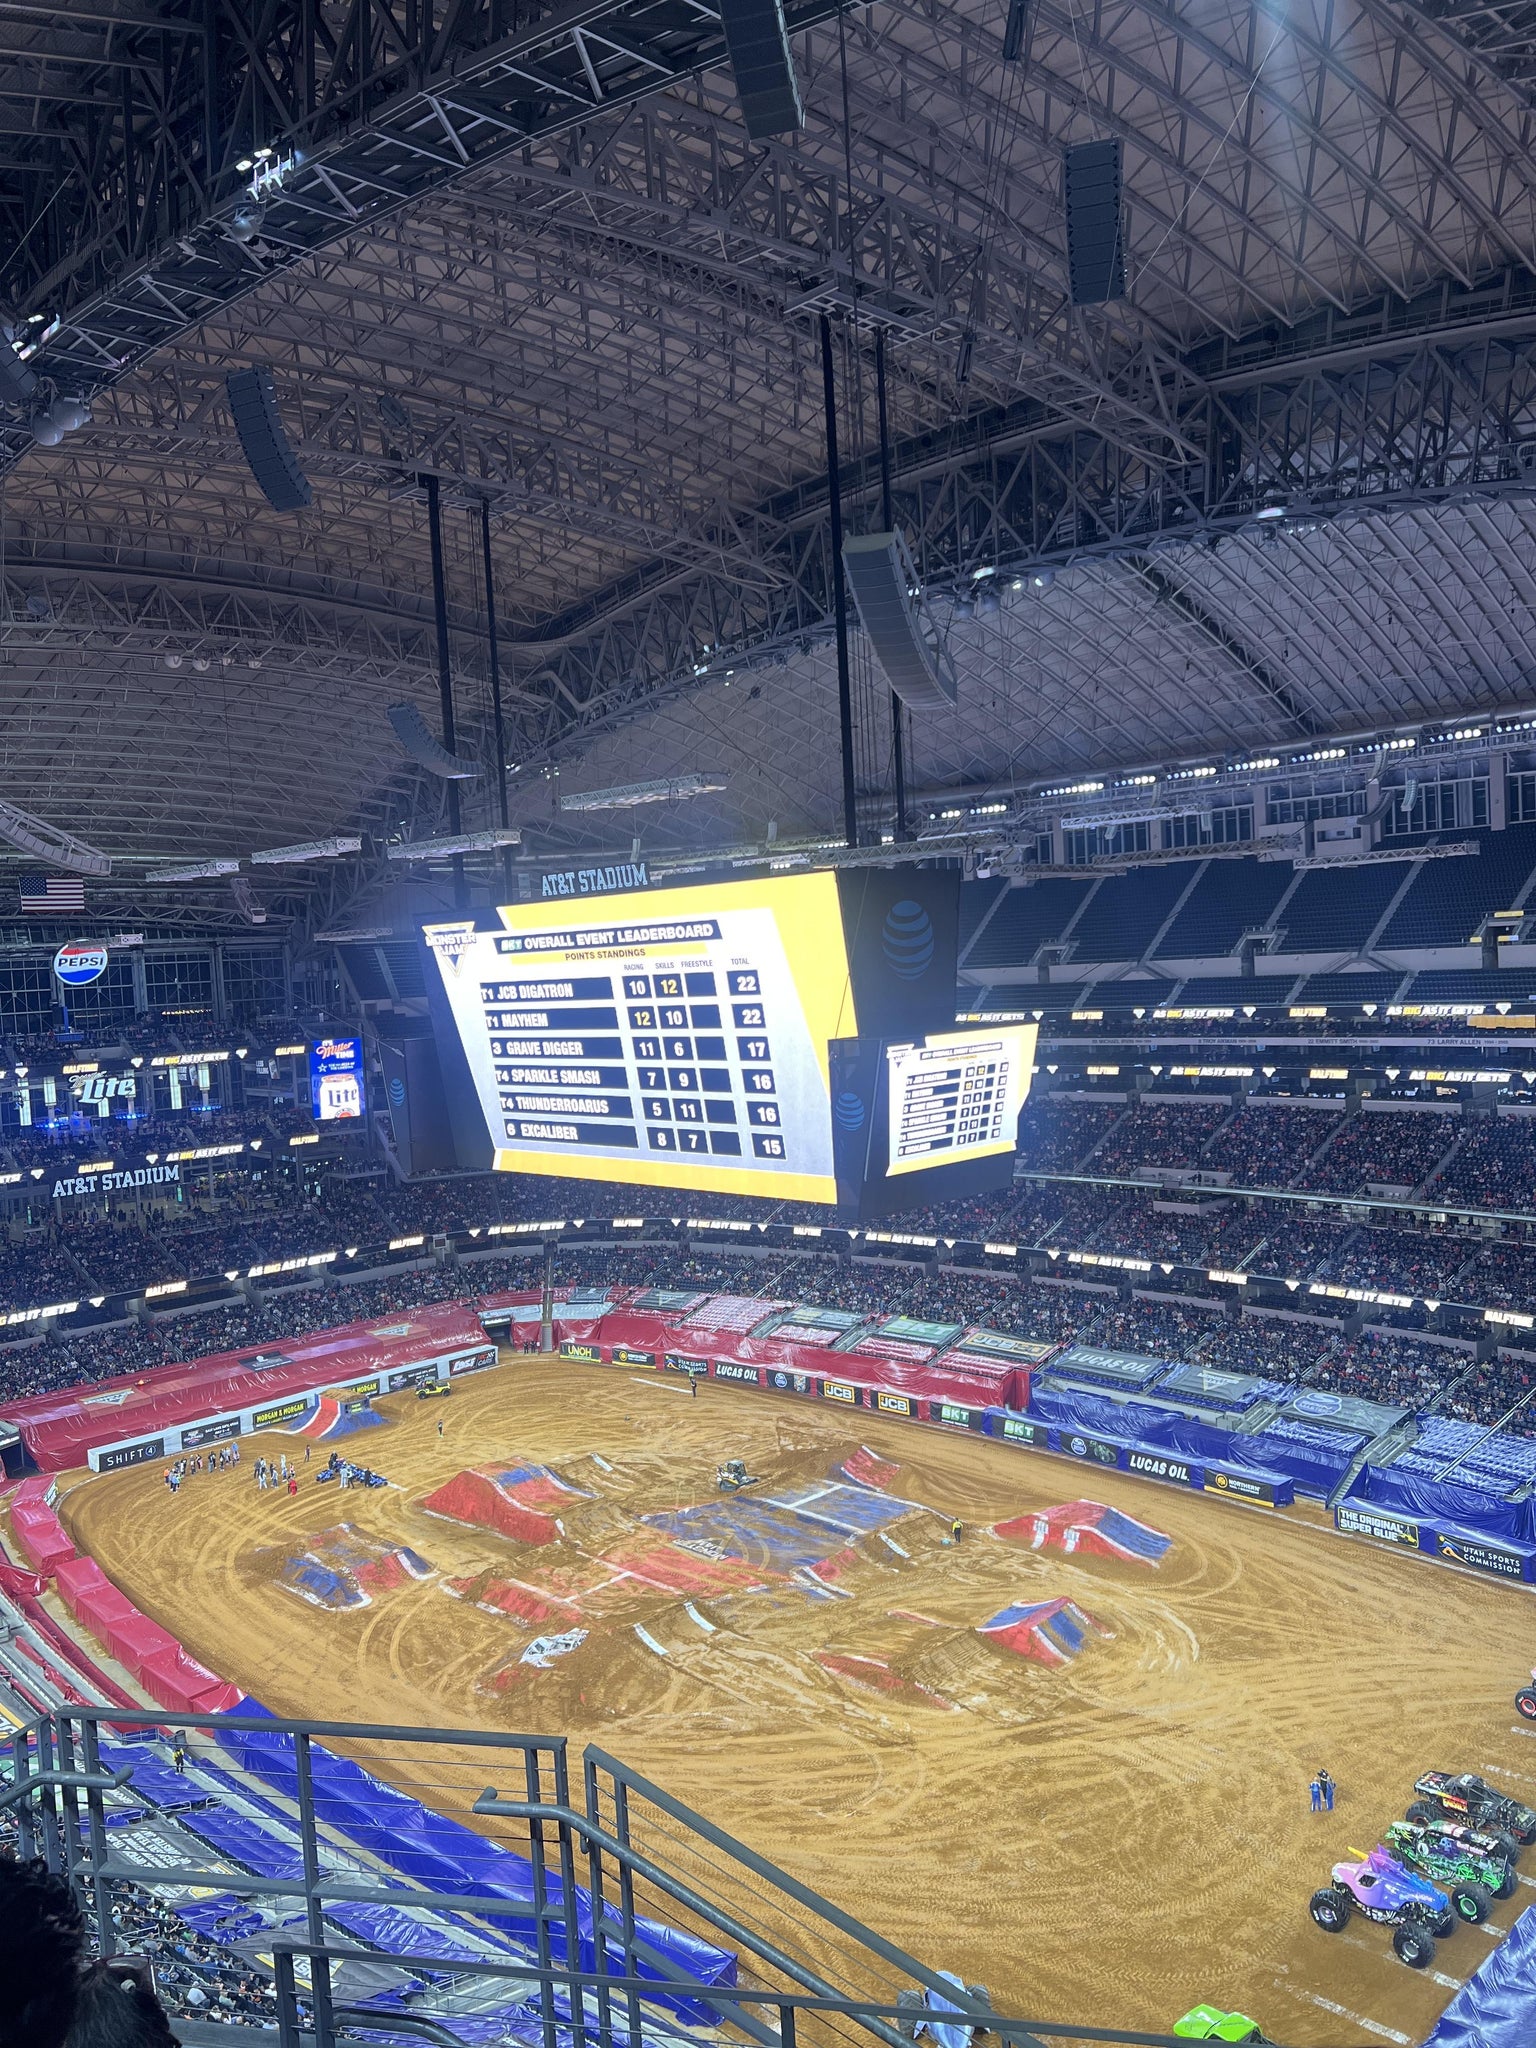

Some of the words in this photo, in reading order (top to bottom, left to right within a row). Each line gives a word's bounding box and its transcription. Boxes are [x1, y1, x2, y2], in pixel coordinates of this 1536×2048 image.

[542, 872, 575, 897] AT&T
[579, 864, 648, 893] STADIUM
[524, 936, 574, 950] OVERALL
[576, 932, 614, 946] EVENT
[617, 924, 714, 943] LEADERBOARD
[58, 956, 103, 968] PEPSI
[565, 950, 594, 961] POINTS
[597, 948, 646, 959] STANDINGS
[655, 962, 674, 970] SKILLS
[680, 960, 713, 968] FREESTYLE
[481, 988, 494, 1000] T1
[498, 986, 518, 1000] JCB
[519, 983, 574, 998] DIGATRON
[629, 980, 646, 995] 10
[660, 980, 678, 994] 12
[737, 976, 757, 992] 22
[486, 1016, 498, 1028] T1
[501, 1014, 548, 1028] MAYHEM
[634, 1012, 650, 1026] 12
[666, 1010, 682, 1026] 10
[742, 1009, 762, 1024] 22
[1153, 1010, 1167, 1018] AS
[1167, 1010, 1182, 1018] BIG
[1182, 1009, 1196, 1018] AS
[1196, 1009, 1206, 1018] IT
[1386, 1006, 1402, 1016] AS
[1402, 1006, 1421, 1016] BIG
[1421, 1006, 1437, 1016] AS
[1437, 1006, 1450, 1016] IT
[316, 1042, 354, 1059] Miller
[336, 1050, 354, 1058] TIME
[492, 1042, 502, 1055] 3
[506, 1042, 541, 1055] GRAVE
[543, 1042, 584, 1055] DIGGER
[640, 1042, 654, 1056] 11
[674, 1042, 684, 1056] 6
[747, 1042, 765, 1058] 17
[496, 1070, 510, 1082] T4
[512, 1069, 559, 1084] SPARKLE
[560, 1070, 600, 1084] SMASH
[647, 1072, 656, 1086] 7
[678, 1073, 689, 1087] 9
[752, 1074, 771, 1090] 16
[1409, 1071, 1426, 1080] AS
[1426, 1071, 1445, 1081] BIG
[1445, 1072, 1461, 1082] AS
[1461, 1072, 1476, 1082] IT
[78, 1076, 136, 1104] Lite
[328, 1089, 357, 1107] Lite
[500, 1098, 514, 1109] T4
[516, 1096, 610, 1114] THUNDERROARUS
[652, 1102, 662, 1116] 5
[680, 1104, 696, 1118] 11
[758, 1107, 777, 1122] 16
[507, 1123, 516, 1136] 6
[521, 1124, 578, 1140] EXCALIBER
[657, 1132, 666, 1146] 8
[688, 1134, 698, 1148] 7
[762, 1140, 781, 1155] 15
[53, 1176, 98, 1197] AT&T
[102, 1165, 180, 1192] STADIUM
[568, 1345, 592, 1357] UNOH
[973, 1336, 1015, 1349] JCB
[1068, 1352, 1122, 1370] LUCAS
[1122, 1362, 1150, 1373] OIL
[716, 1364, 743, 1378] LUCAS
[744, 1368, 758, 1380] OIL
[356, 1383, 377, 1393] MORGAN
[826, 1385, 851, 1399] JCB
[880, 1396, 907, 1411] JCB
[256, 1411, 278, 1423] MORGAN
[279, 1409, 283, 1418] &
[284, 1403, 305, 1415] MORGAN
[942, 1406, 968, 1422] BKT
[1004, 1420, 1034, 1438] BKT
[107, 1449, 143, 1467] SHIFT
[1130, 1455, 1167, 1475] LUCAS
[1228, 1479, 1260, 1492] NORTHERN
[1340, 1510, 1358, 1522] THE
[1360, 1514, 1402, 1533] ORIGINAL
[1340, 1519, 1371, 1536] SUPER
[1373, 1527, 1399, 1542] GLUE
[1464, 1546, 1486, 1558] UTAH
[1488, 1552, 1520, 1567] SPORTS
[1464, 1554, 1521, 1575] COMMISSION
[131, 1832, 152, 1845] TEAM
